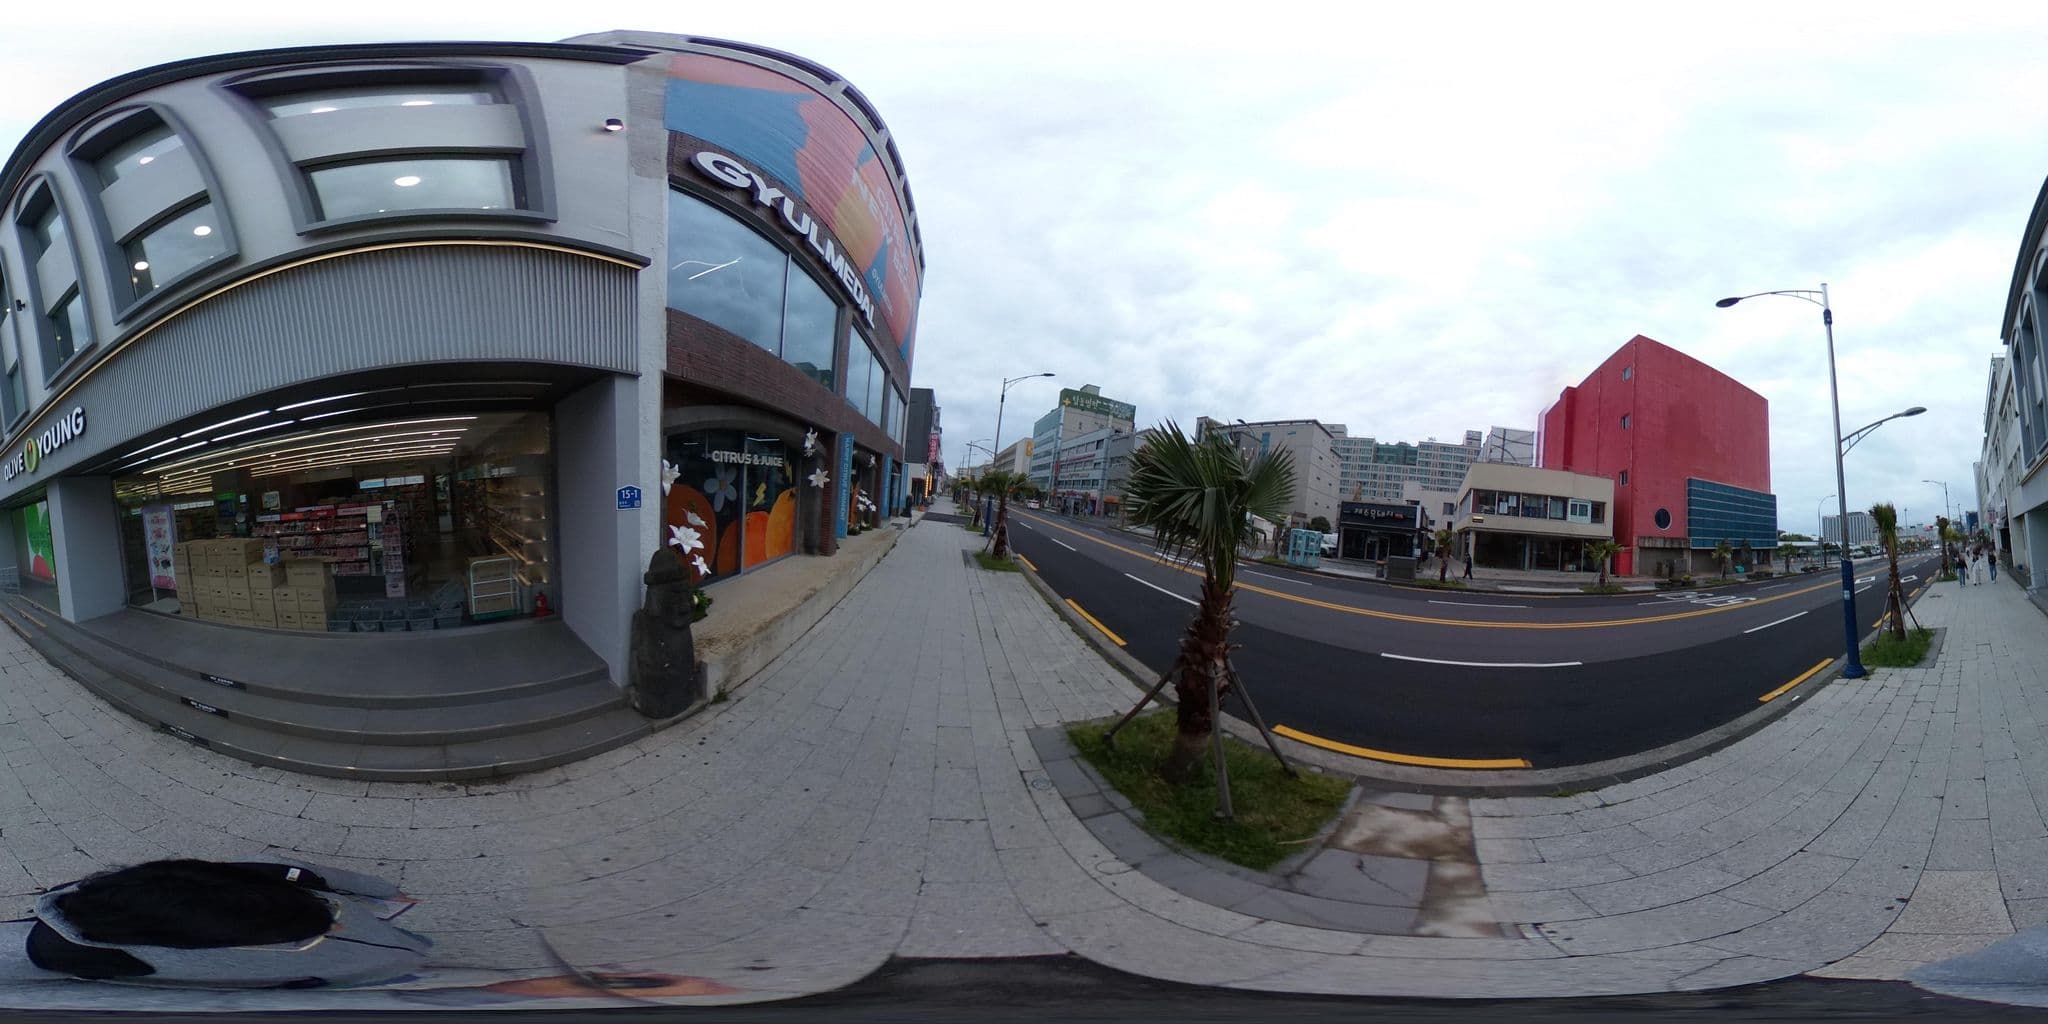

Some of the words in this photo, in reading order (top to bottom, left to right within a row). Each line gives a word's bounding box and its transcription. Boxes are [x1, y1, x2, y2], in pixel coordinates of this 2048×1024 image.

[694, 151, 875, 330] GYULMEDAL
[4, 452, 24, 481] OLIVE
[36, 406, 84, 458] YOUNG
[712, 450, 752, 465] CITRUS
[753, 454, 760, 465] &
[760, 455, 783, 467] JUICE
[621, 489, 638, 499] 15-1
